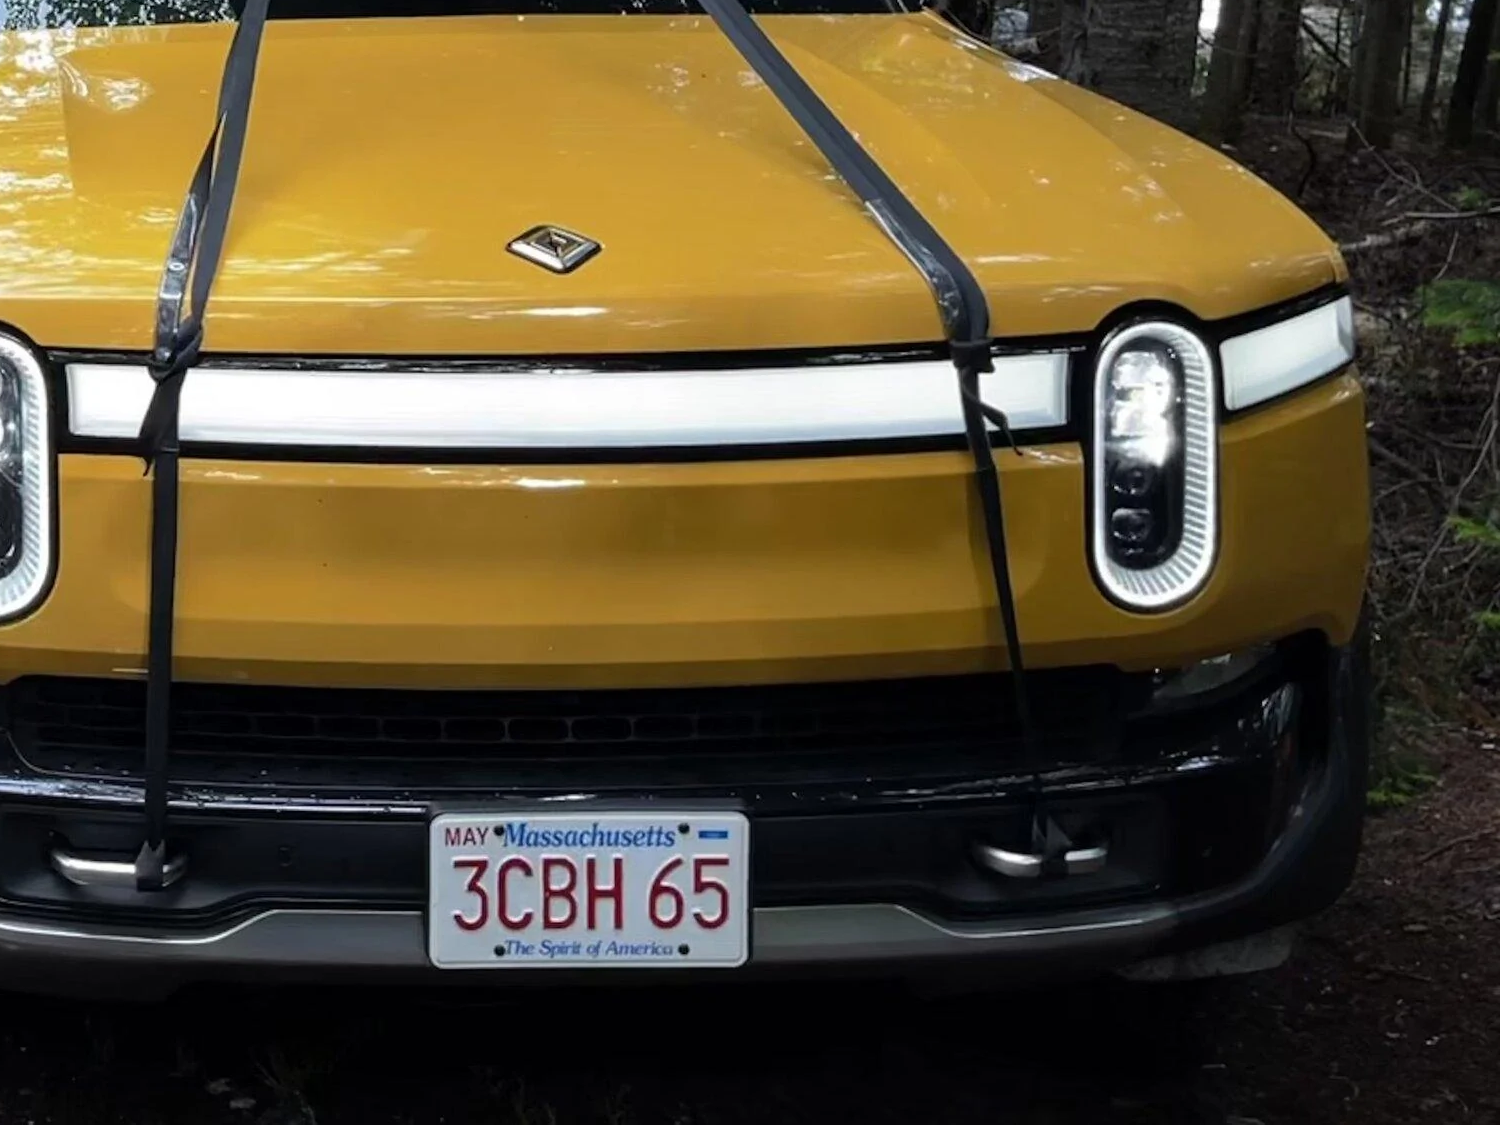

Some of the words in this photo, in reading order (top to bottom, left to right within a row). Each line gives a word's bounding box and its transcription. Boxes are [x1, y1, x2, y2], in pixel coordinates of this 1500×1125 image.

[445, 828, 489, 847] MAY
[502, 823, 676, 848] Massachusetts
[453, 856, 623, 931] 3CBH
[648, 856, 730, 930] 65
[505, 940, 534, 956] The
[539, 940, 581, 959] Spirit
[586, 940, 602, 958] of
[605, 940, 674, 957] America
